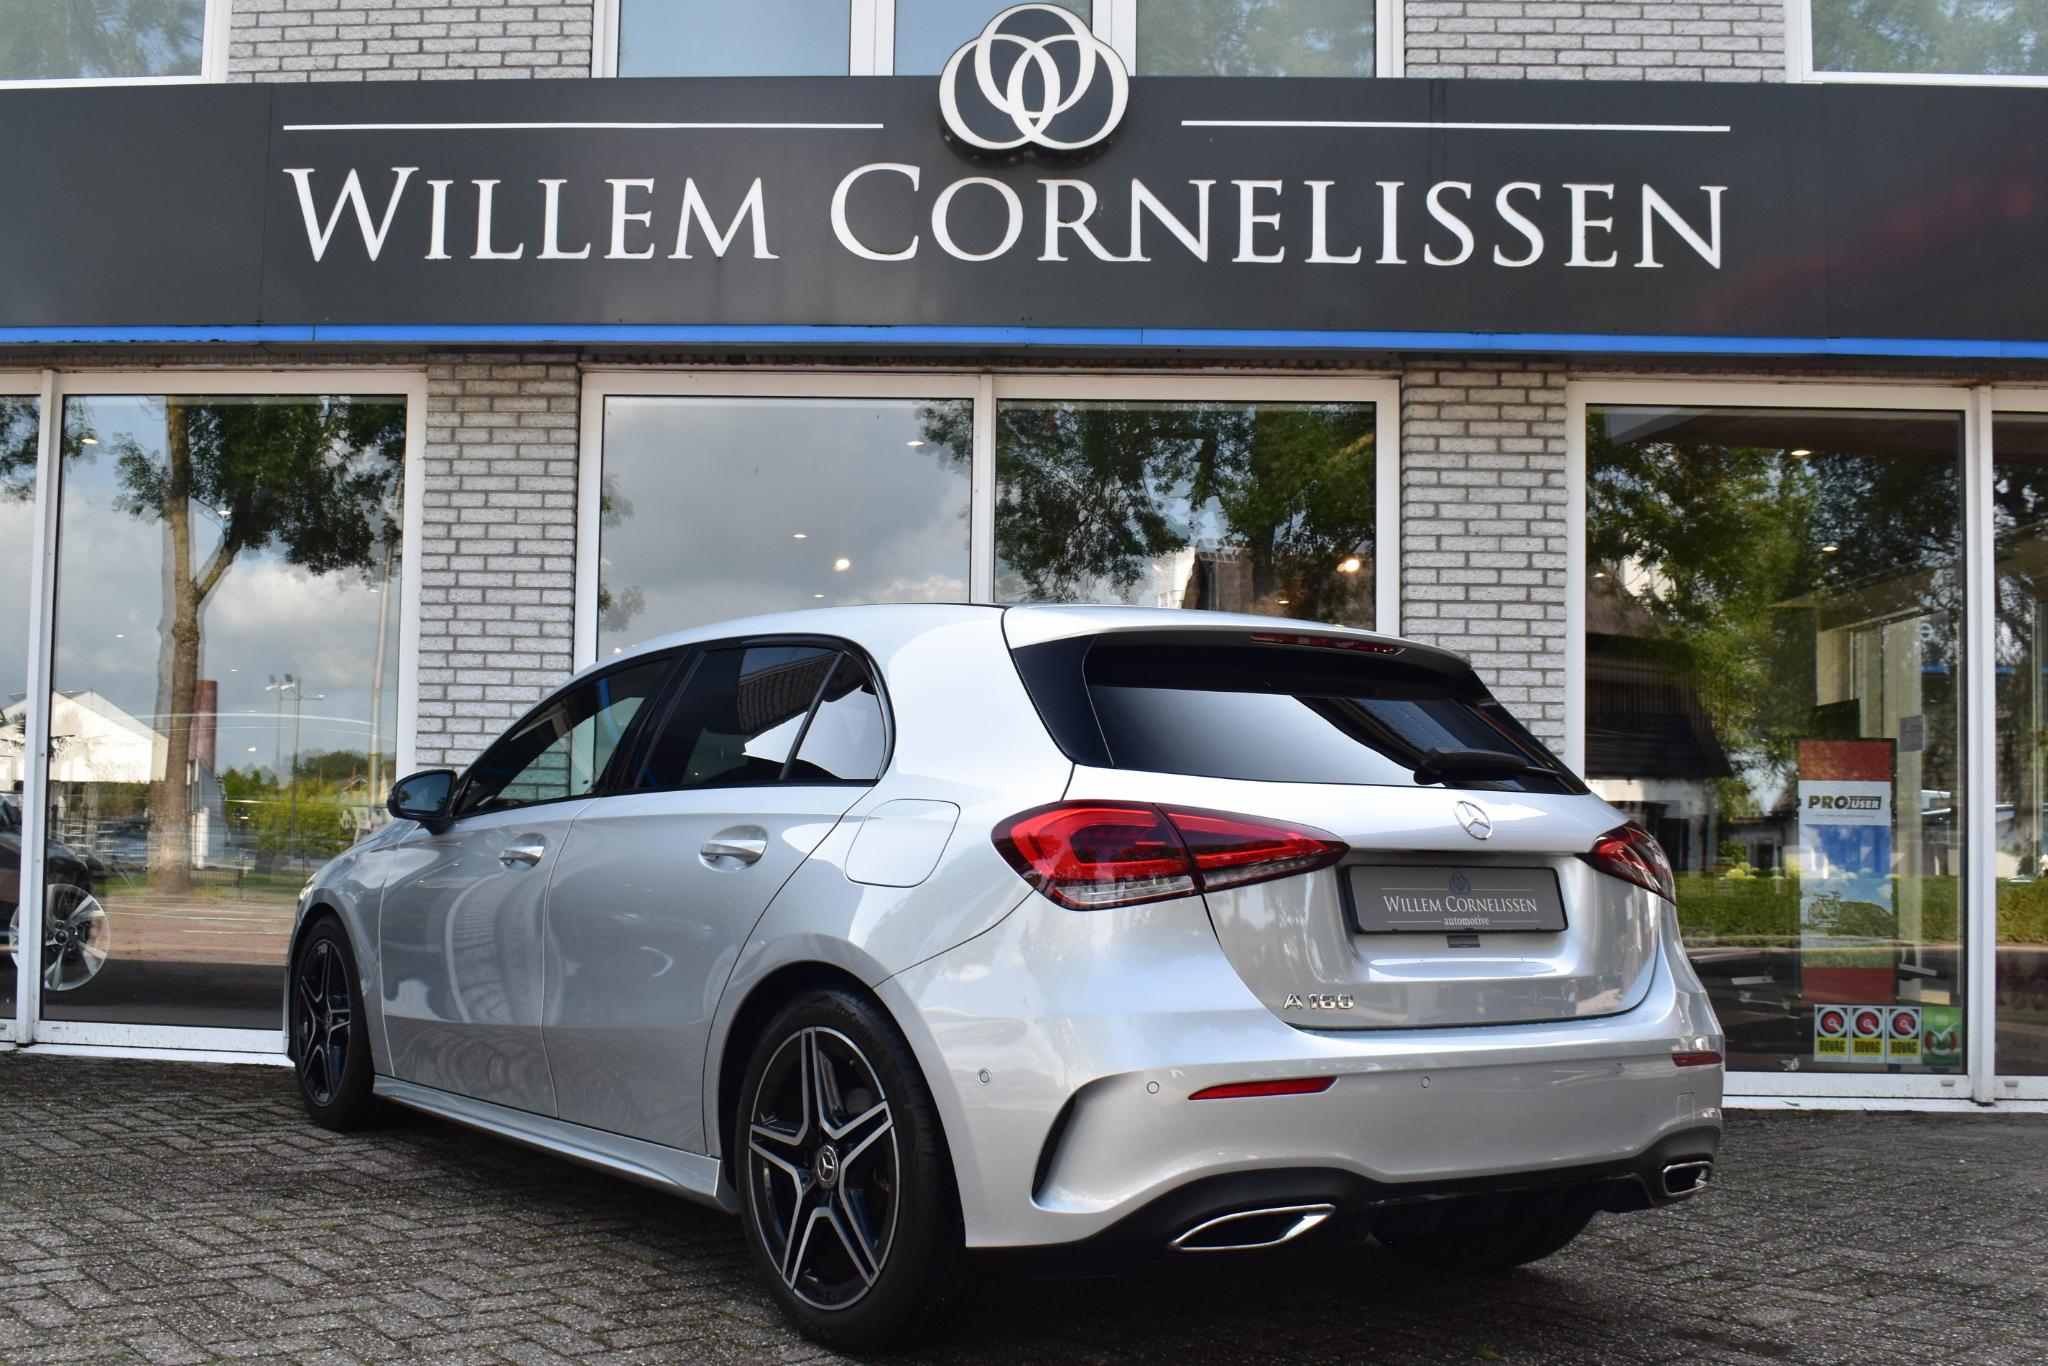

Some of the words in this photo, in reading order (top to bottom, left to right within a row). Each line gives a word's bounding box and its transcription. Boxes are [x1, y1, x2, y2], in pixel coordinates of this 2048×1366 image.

[283, 166, 780, 262] WILLEM
[831, 162, 1728, 270] CORNELISSEN
[1808, 795, 1849, 809] PRO
[1851, 799, 1880, 809] USER
[1382, 895, 1442, 912] WILLEM
[1445, 896, 1538, 912] CORNELISSEN
[1443, 915, 1490, 926] automotive
[1283, 993, 1304, 1009] A
[1819, 1040, 1846, 1053] BOVAG
[1854, 1040, 1881, 1054] BOVAG
[1891, 1041, 1917, 1054] BOVAG
